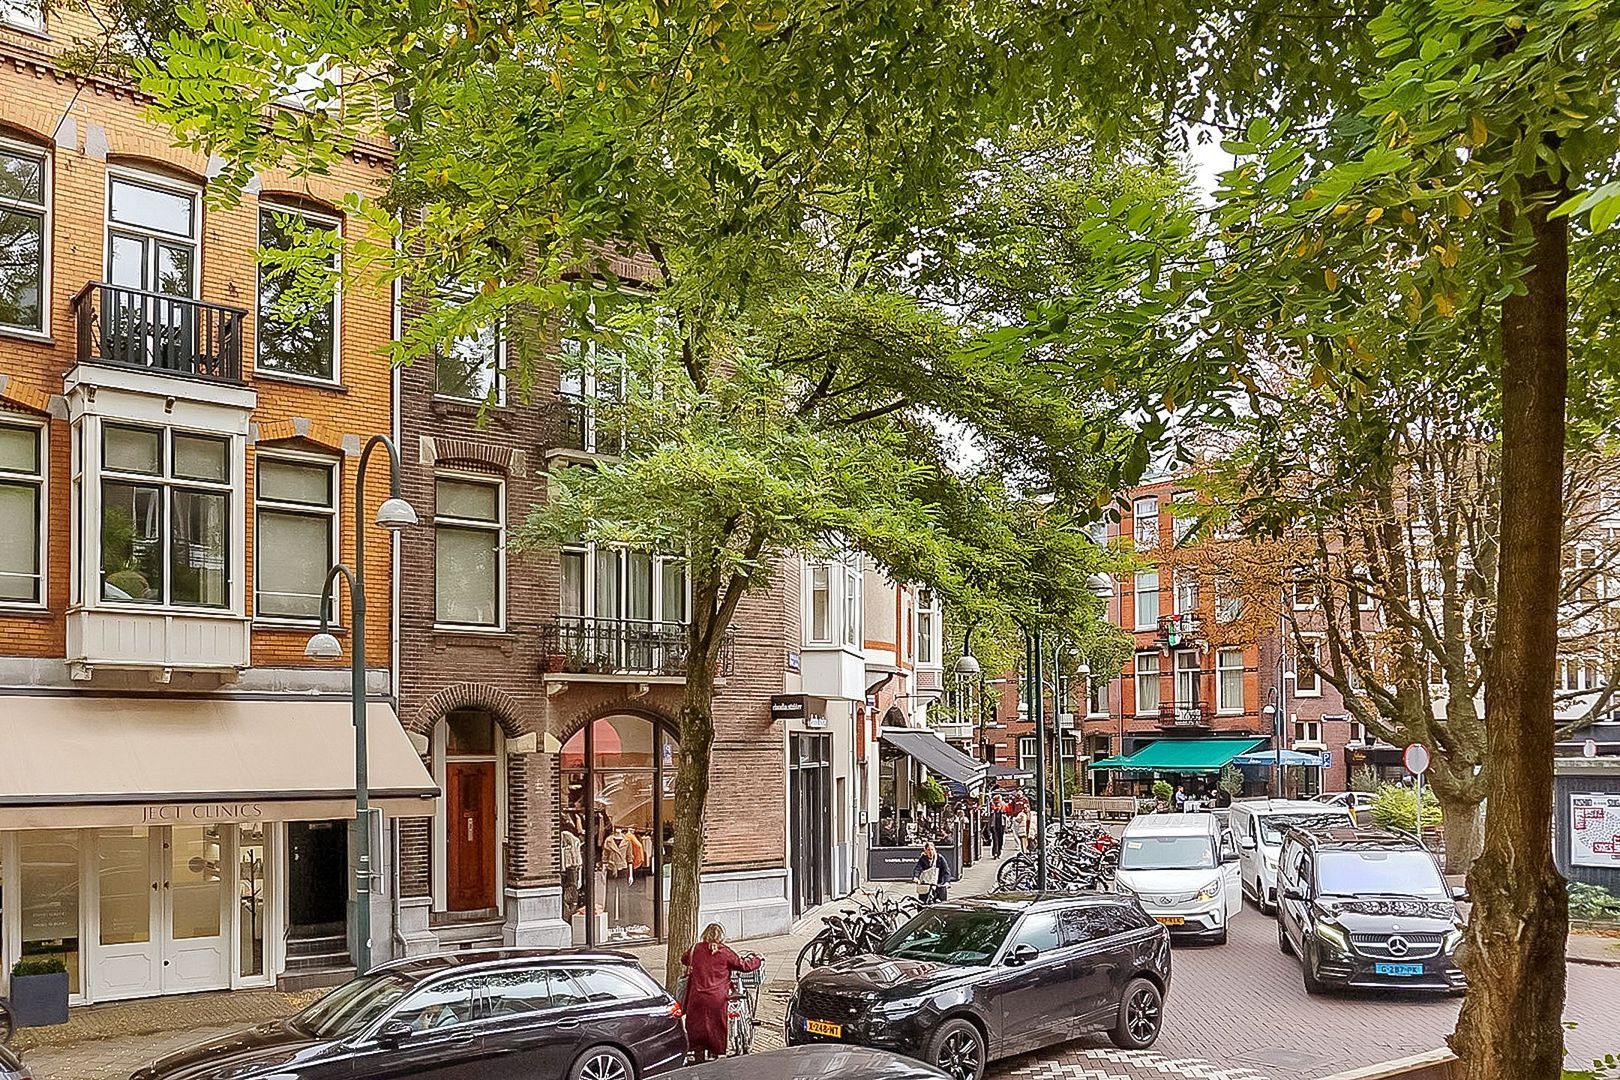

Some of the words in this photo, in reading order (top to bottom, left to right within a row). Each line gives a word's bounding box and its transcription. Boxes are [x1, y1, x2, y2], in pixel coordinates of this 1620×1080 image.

[142, 806, 182, 823] JECT
[192, 804, 262, 818] CLINICS
[808, 1022, 839, 1035] X-248-NT
